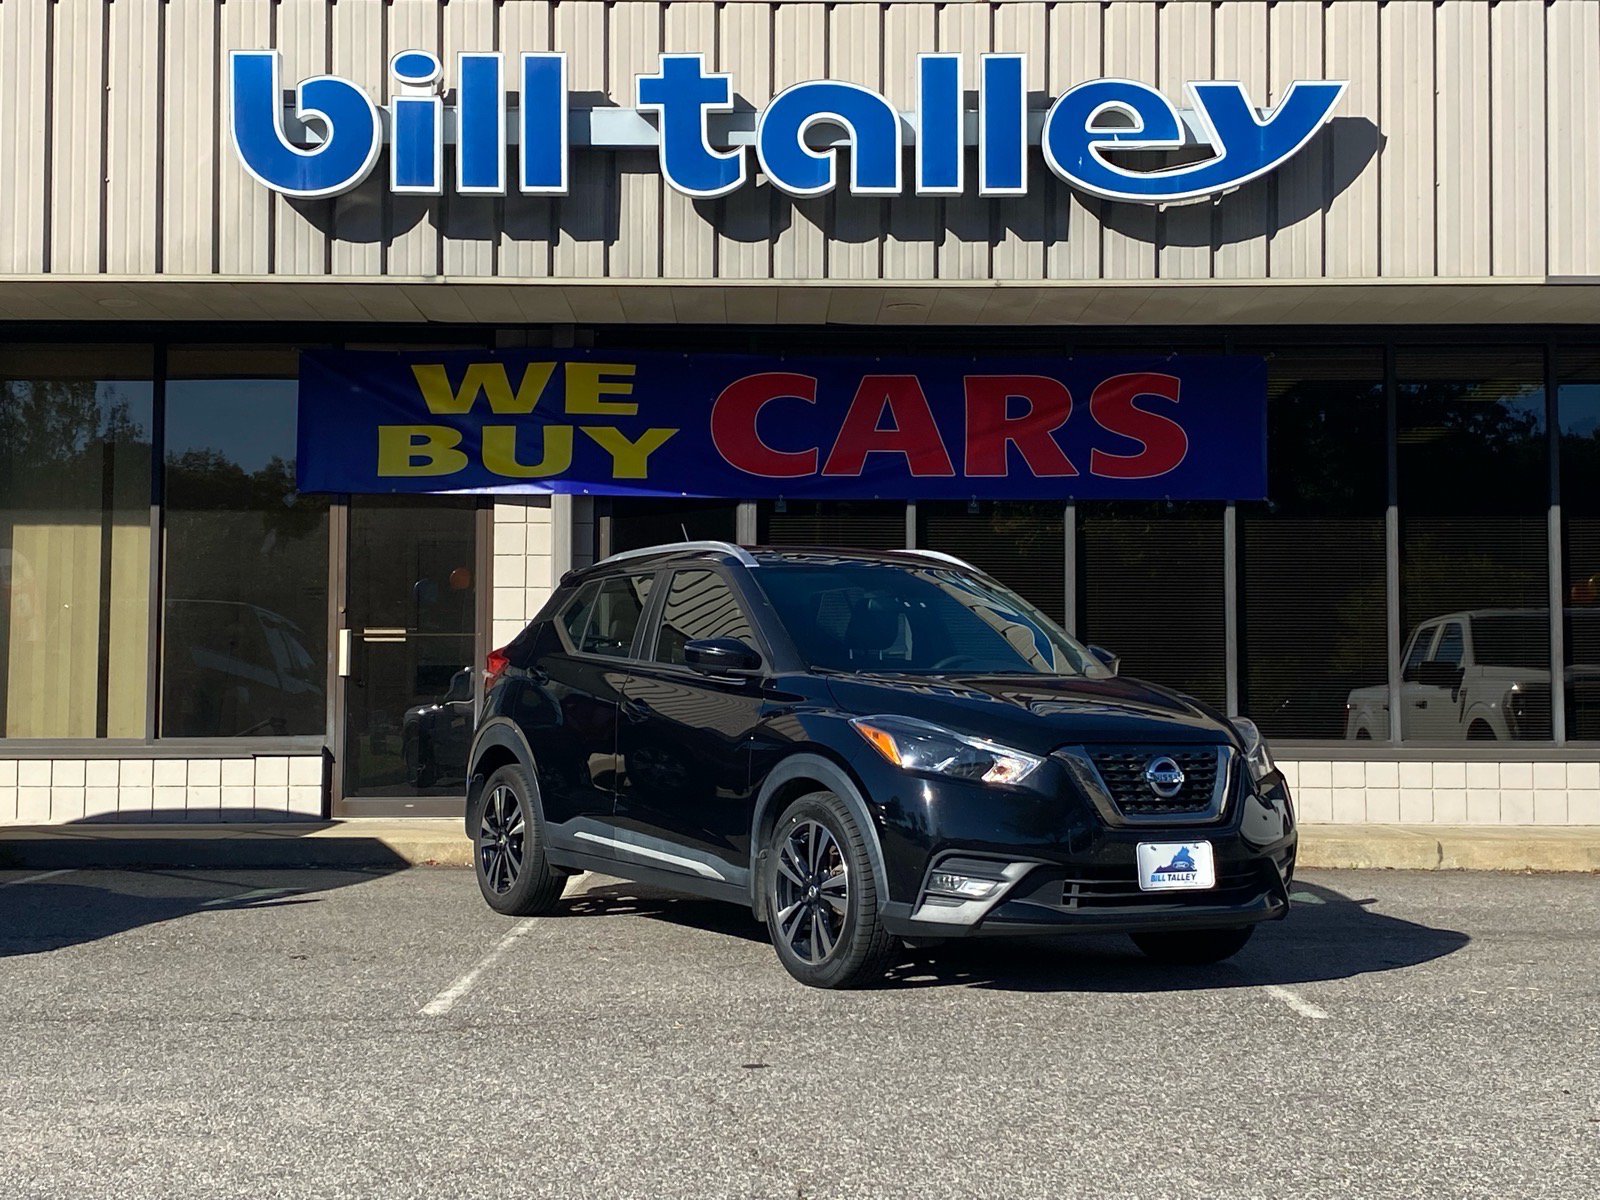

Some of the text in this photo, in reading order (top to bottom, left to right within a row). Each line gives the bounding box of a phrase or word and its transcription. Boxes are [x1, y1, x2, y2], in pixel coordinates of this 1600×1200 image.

[229, 49, 1350, 203] bill talley
[411, 361, 639, 415] WE
[377, 425, 680, 479] BUY
[710, 372, 1189, 479] CARS
[1150, 873, 1197, 883] BILL TALLEY
